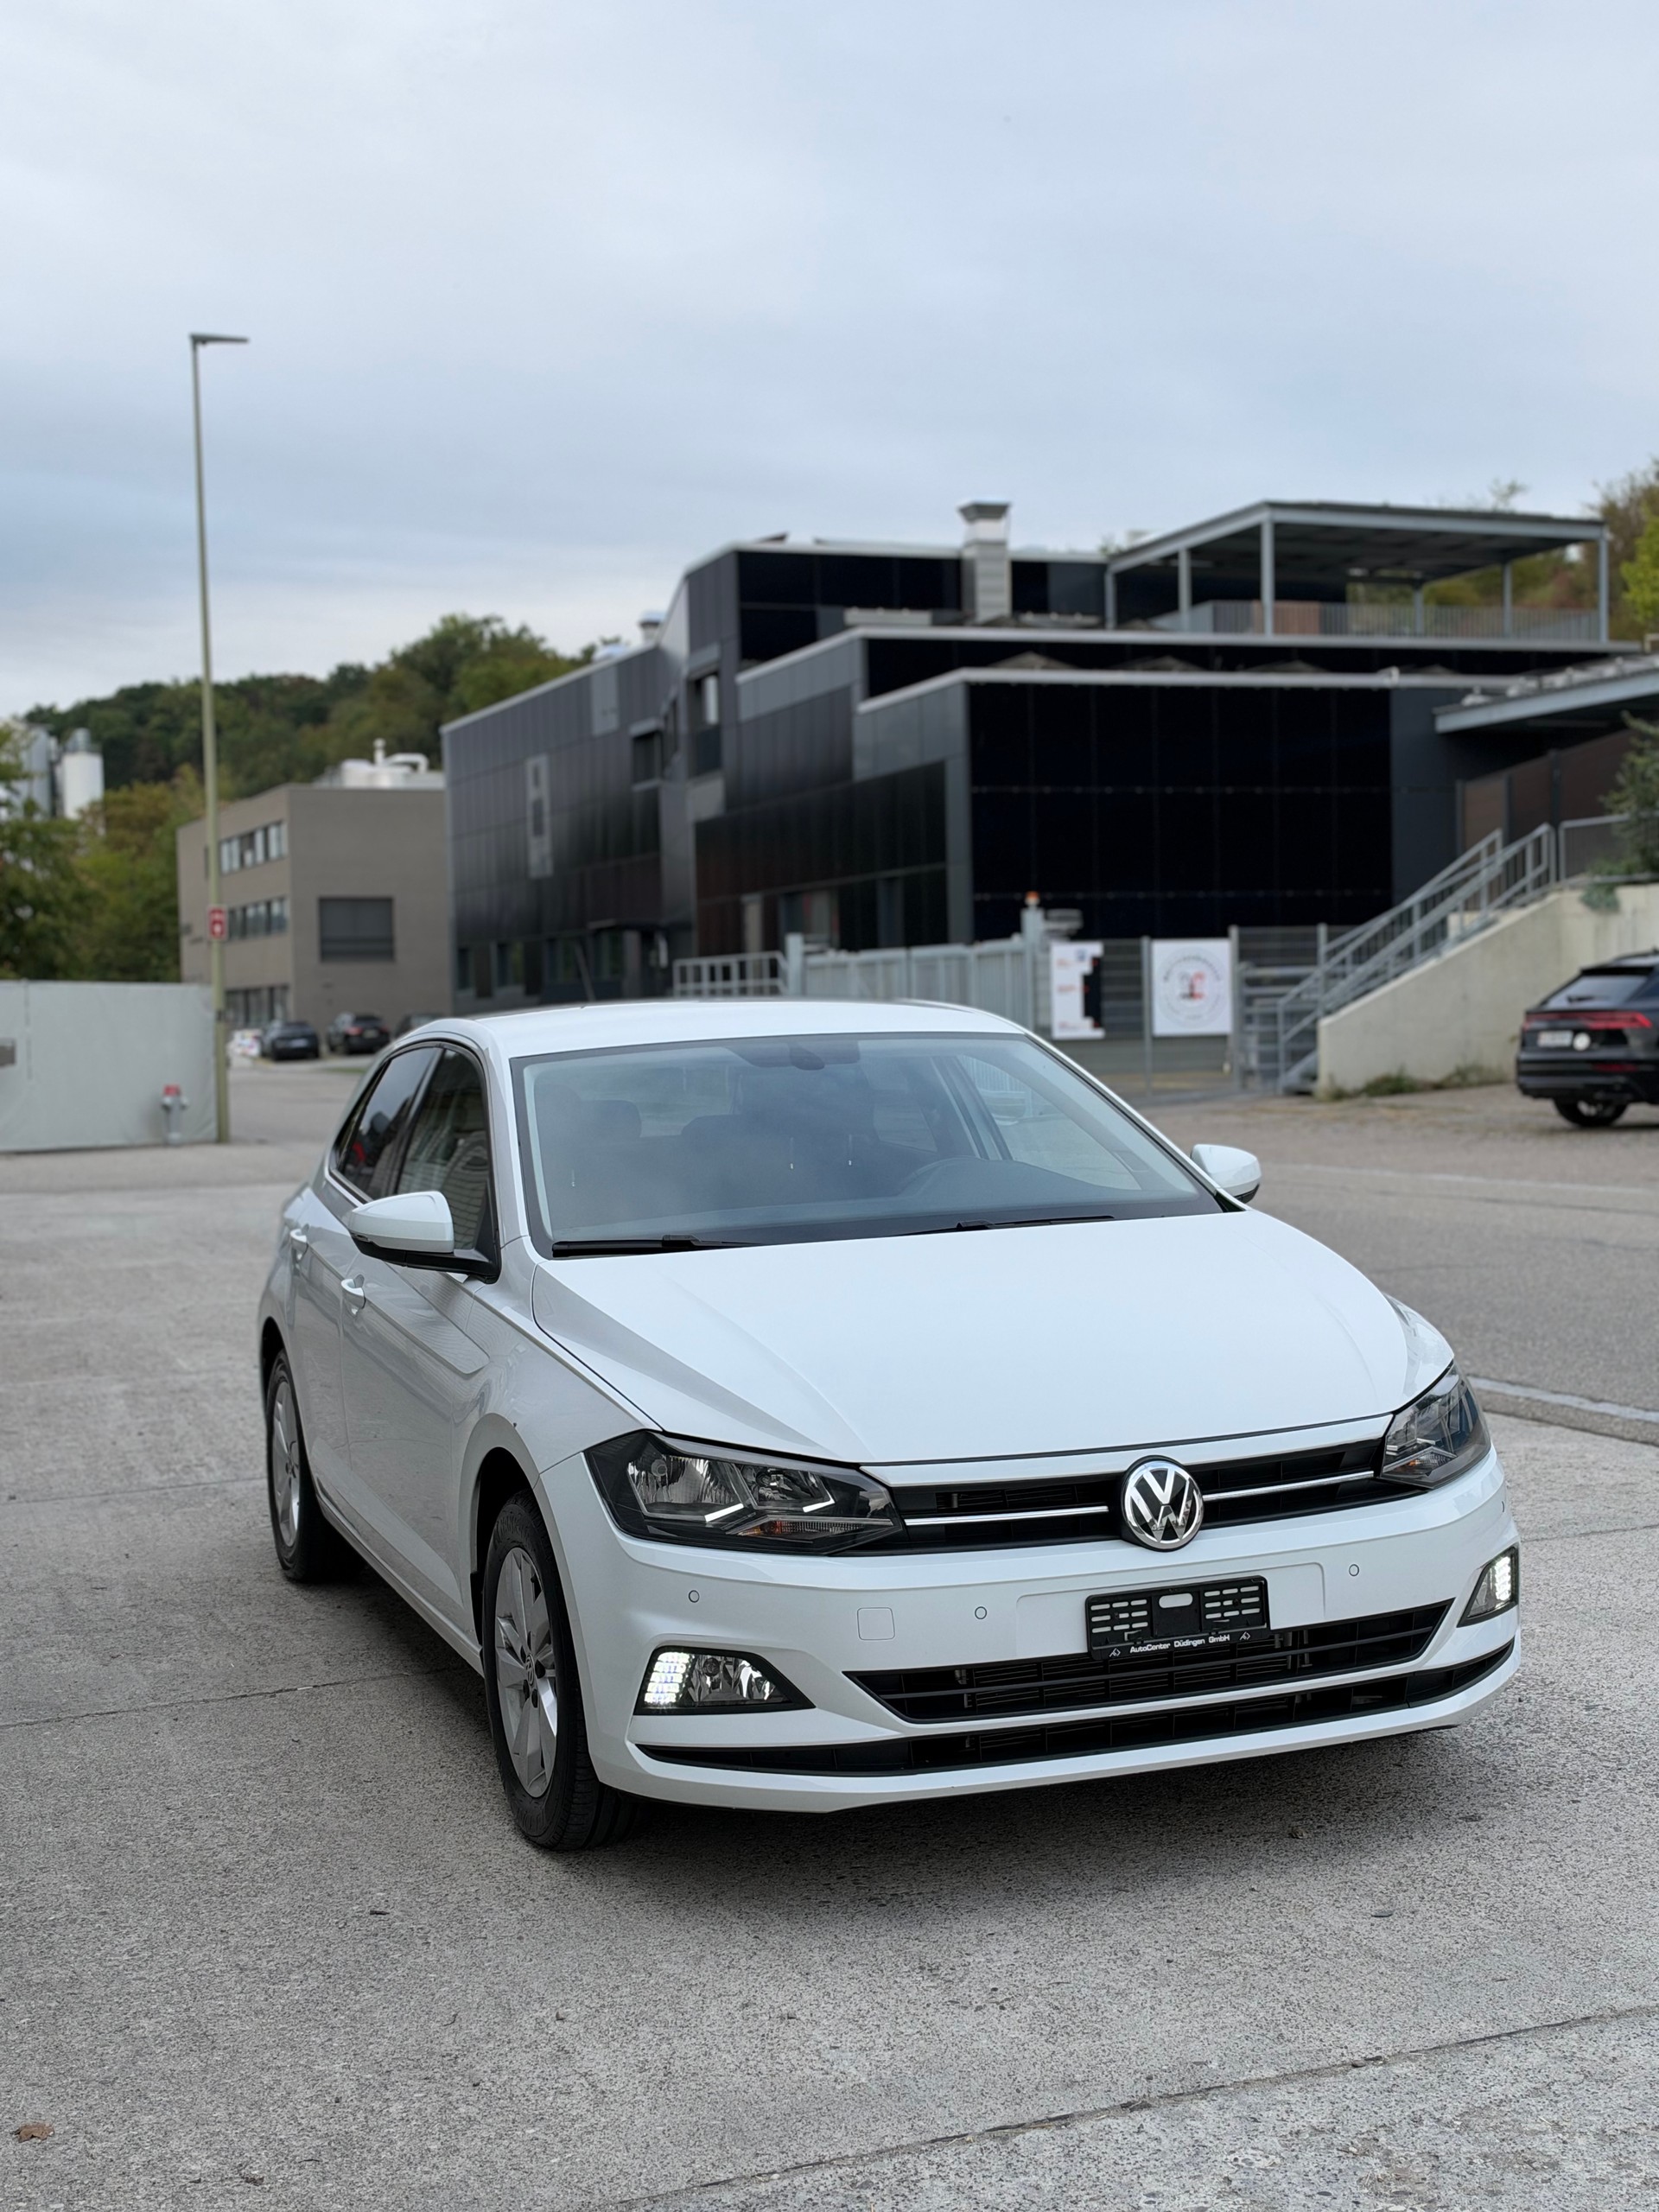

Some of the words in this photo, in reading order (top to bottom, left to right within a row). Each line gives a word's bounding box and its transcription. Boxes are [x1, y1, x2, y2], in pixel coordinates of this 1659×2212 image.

[1125, 1462, 1200, 1547] VW
[1130, 1643, 1170, 1654] AutoCenter
[1174, 1638, 1205, 1648] Düdingen
[1209, 1634, 1230, 1643] GmbH
